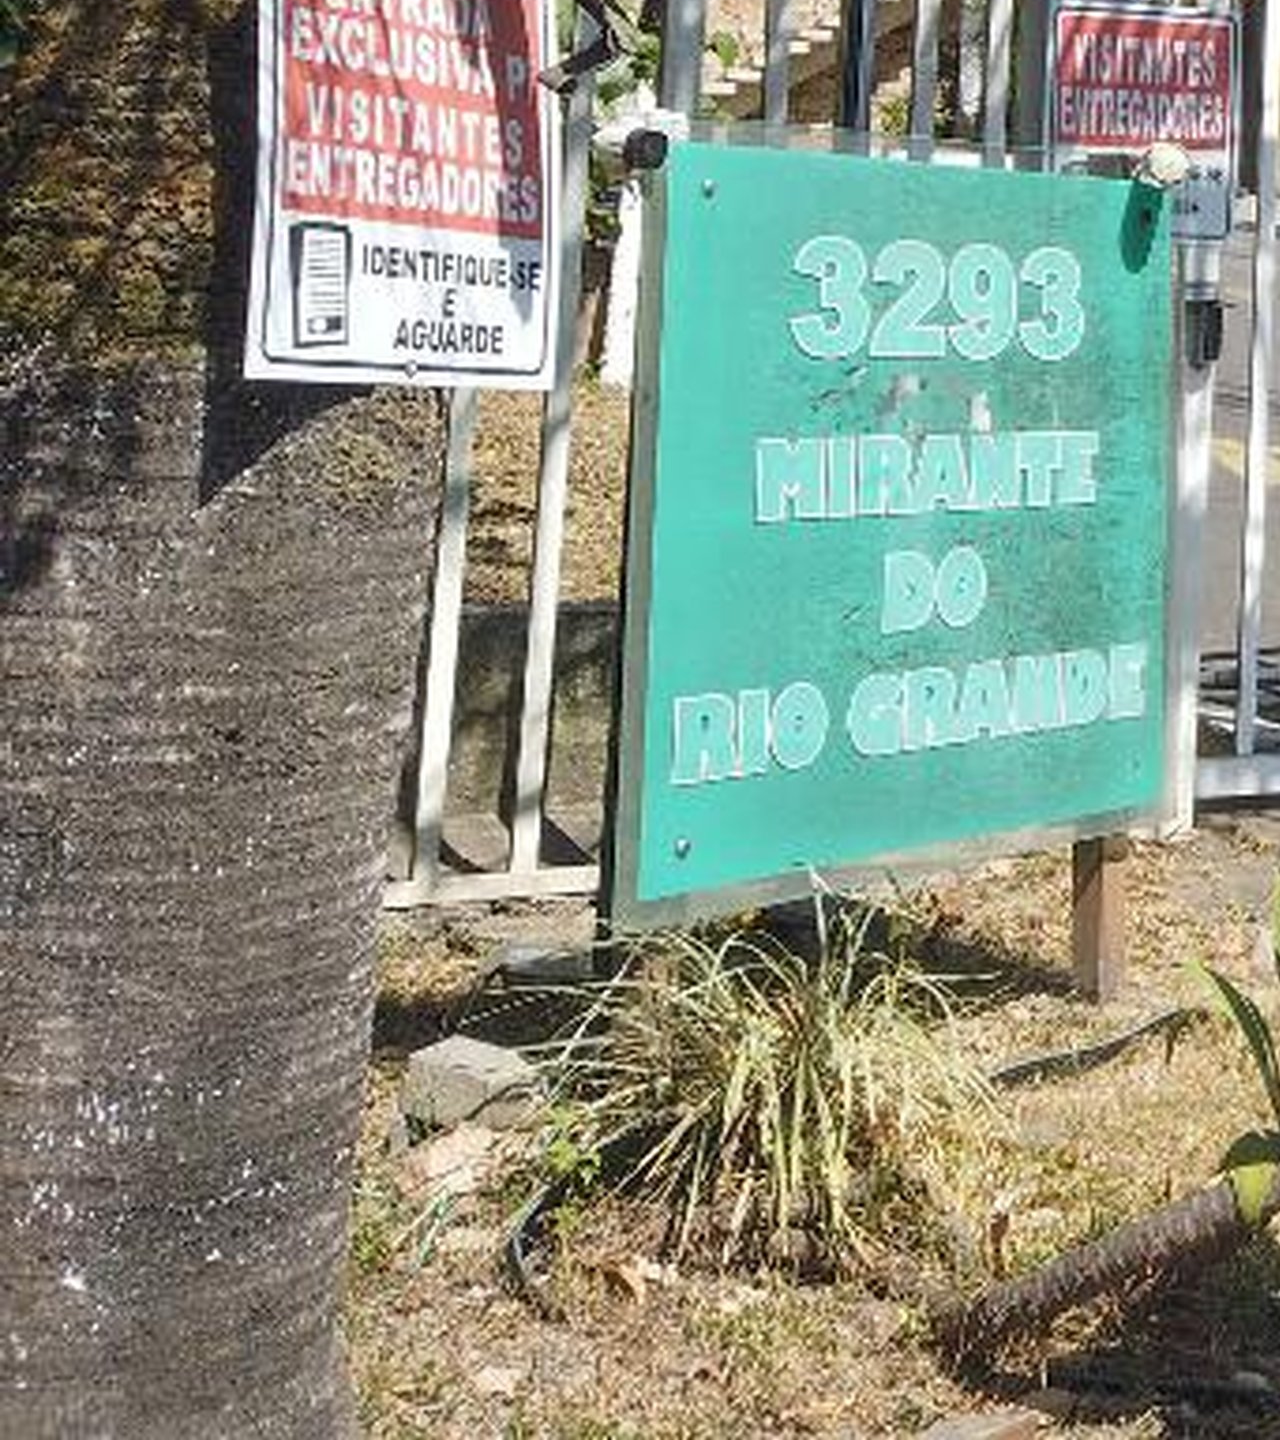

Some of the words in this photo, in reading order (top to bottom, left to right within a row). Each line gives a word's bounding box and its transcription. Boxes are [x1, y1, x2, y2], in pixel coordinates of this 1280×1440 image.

[291, 6, 497, 99] EXCLUSIVA
[1073, 32, 1217, 87] VISITANTES
[306, 80, 524, 168] VISITANTES
[1059, 86, 1225, 140] ENTREGADORES
[287, 137, 540, 224] ENTREGADORES
[392, 318, 504, 355] AGUARDE
[441, 288, 458, 318] E
[786, 233, 1087, 361] 3293
[753, 428, 1101, 526] MIRANTE
[880, 544, 989, 636] DO
[667, 679, 832, 787] RIO
[846, 641, 1149, 759] GRANDE
